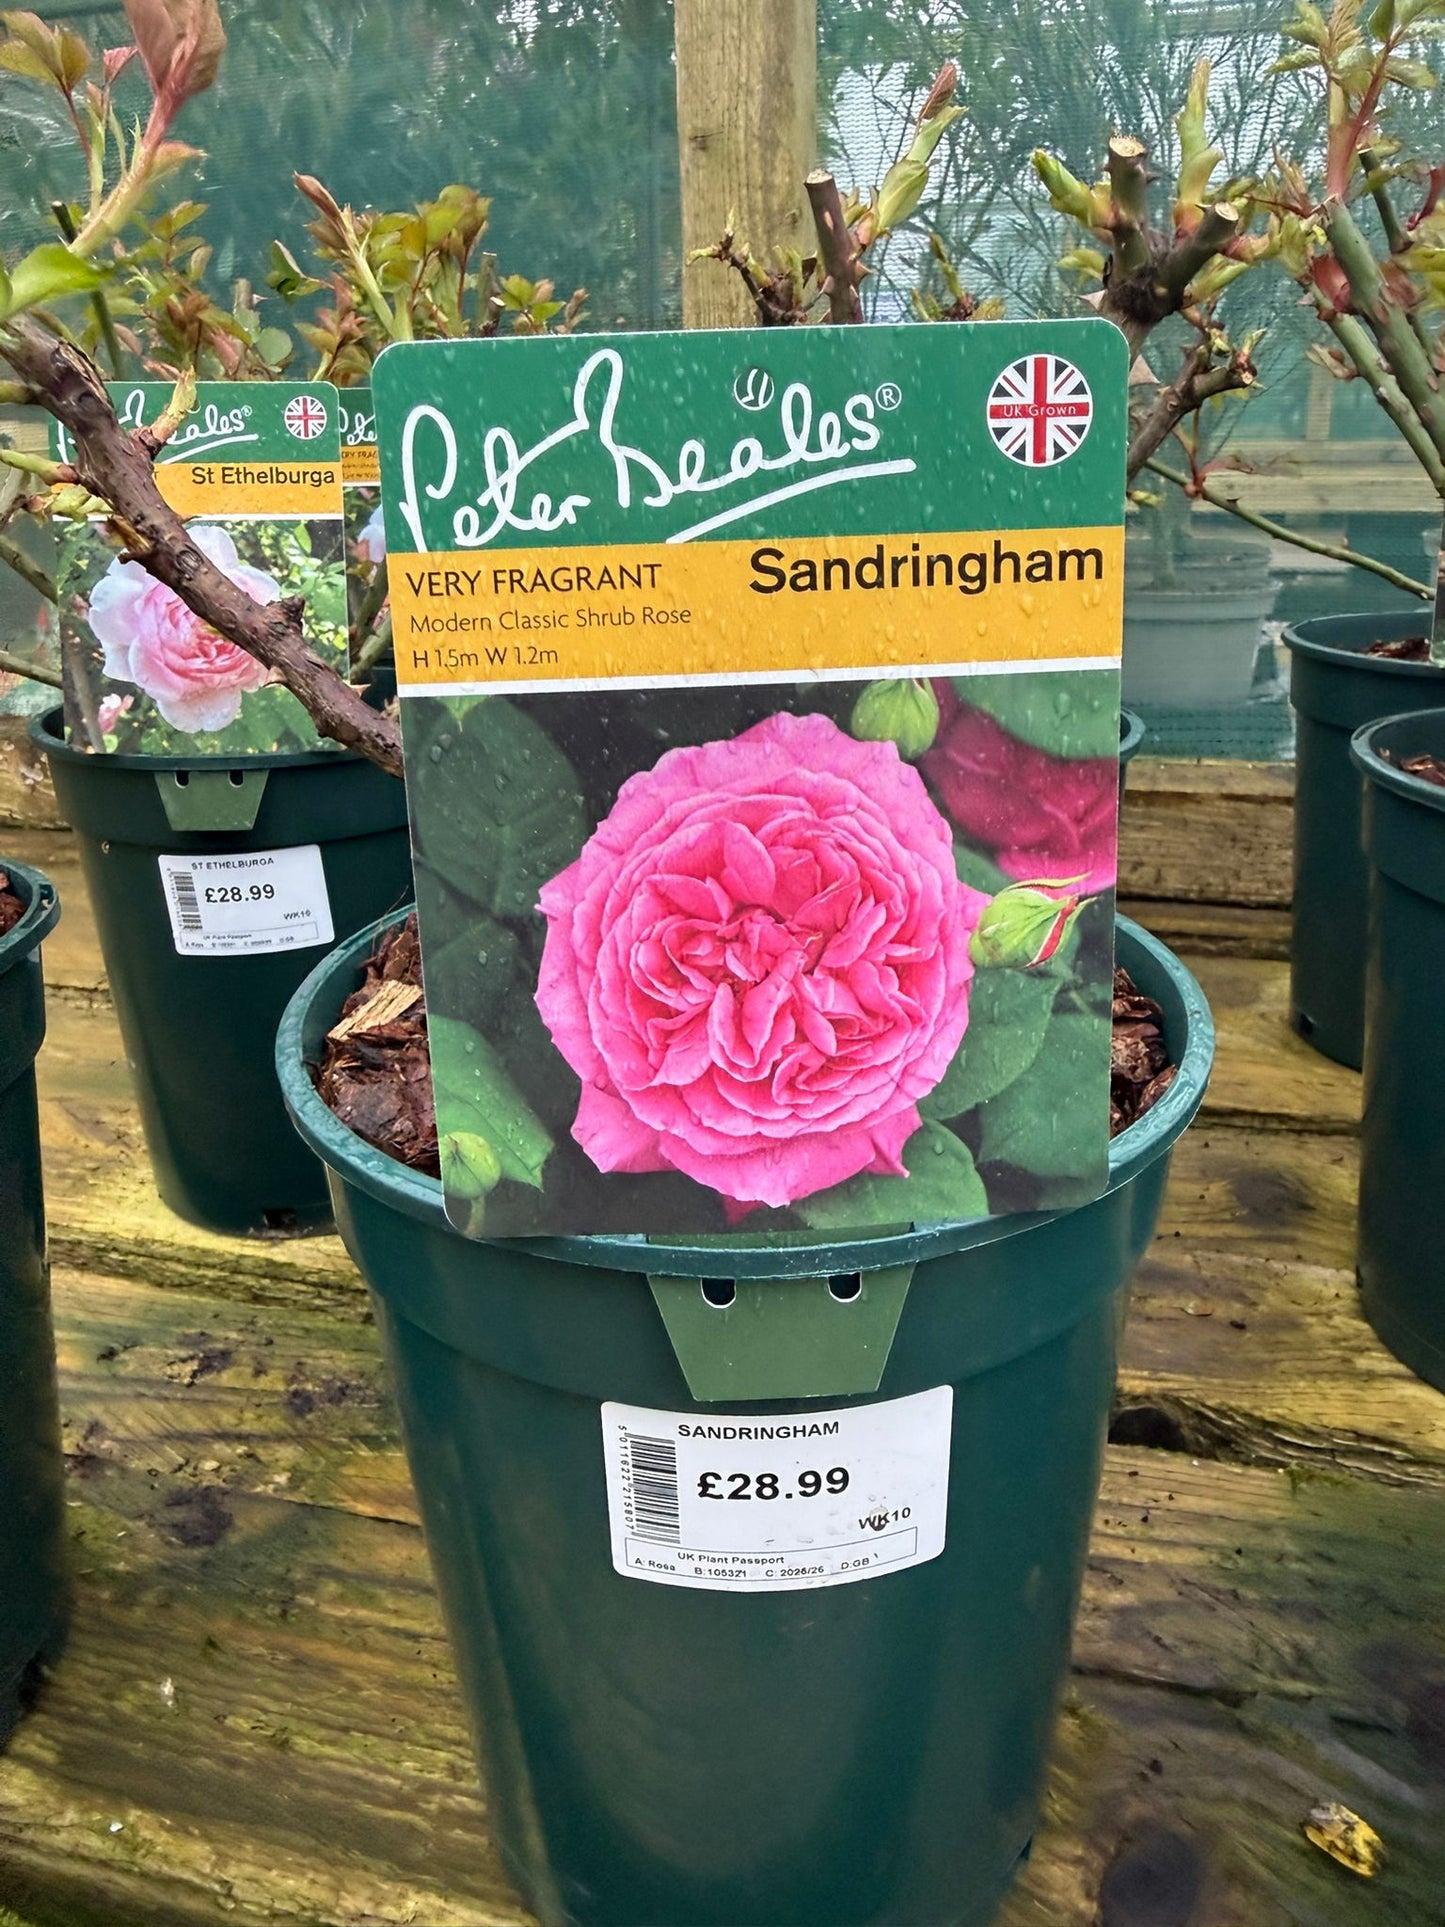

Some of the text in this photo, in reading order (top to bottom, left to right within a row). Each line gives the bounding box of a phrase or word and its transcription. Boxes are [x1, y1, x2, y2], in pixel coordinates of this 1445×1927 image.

[1003, 404, 1076, 417] UK Grown
[192, 466, 335, 488] St Ethelburga
[399, 404, 591, 553] Peter
[749, 539, 1103, 595] Sandringham
[405, 563, 663, 598] VERY FRAGRANT
[410, 605, 693, 634] Modern Classic Shrub Rose
[413, 646, 559, 669] H 1.5m W 1.2m
[191, 862, 204, 871] ST
[205, 883, 275, 904] £28.99
[677, 1421, 840, 1440] SANDRINGHAM
[697, 1466, 850, 1501] £28.99
[858, 1506, 911, 1531] WK10
[648, 1559, 676, 1572] Rosa
[677, 1551, 785, 1567] UK Plant Passport
